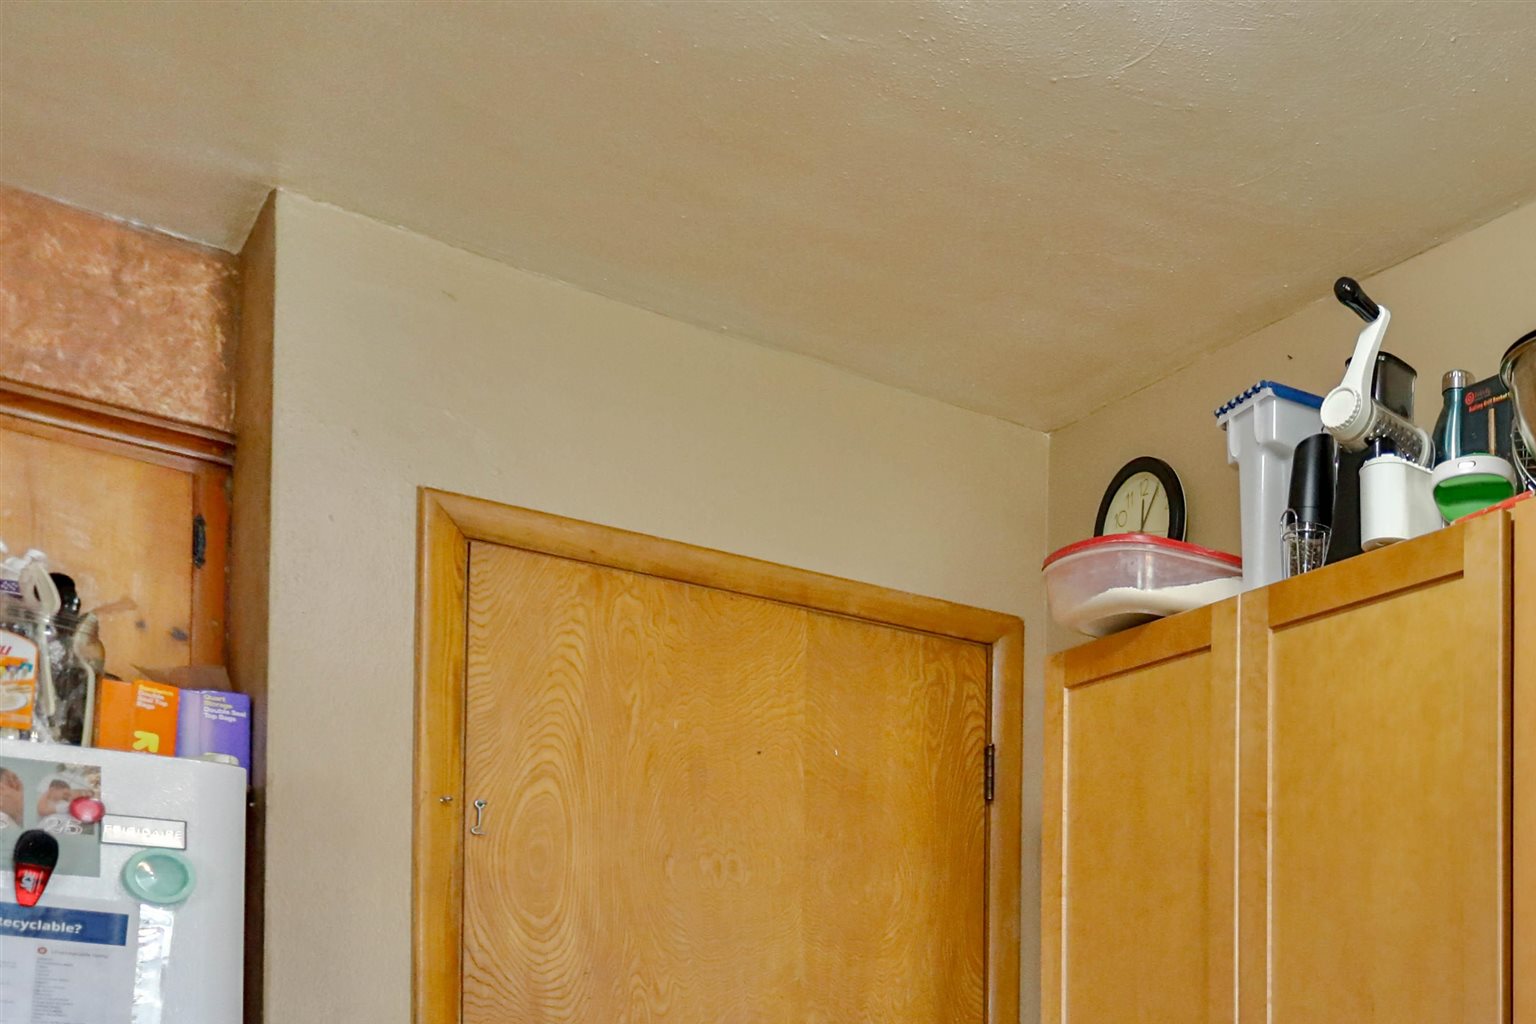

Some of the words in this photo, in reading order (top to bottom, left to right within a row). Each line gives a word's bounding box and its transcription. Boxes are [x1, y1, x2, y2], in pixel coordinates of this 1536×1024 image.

[1139, 478, 1149, 496] 12
[1114, 510, 1127, 529] 10
[103, 824, 183, 840] FRIGIDAIRE
